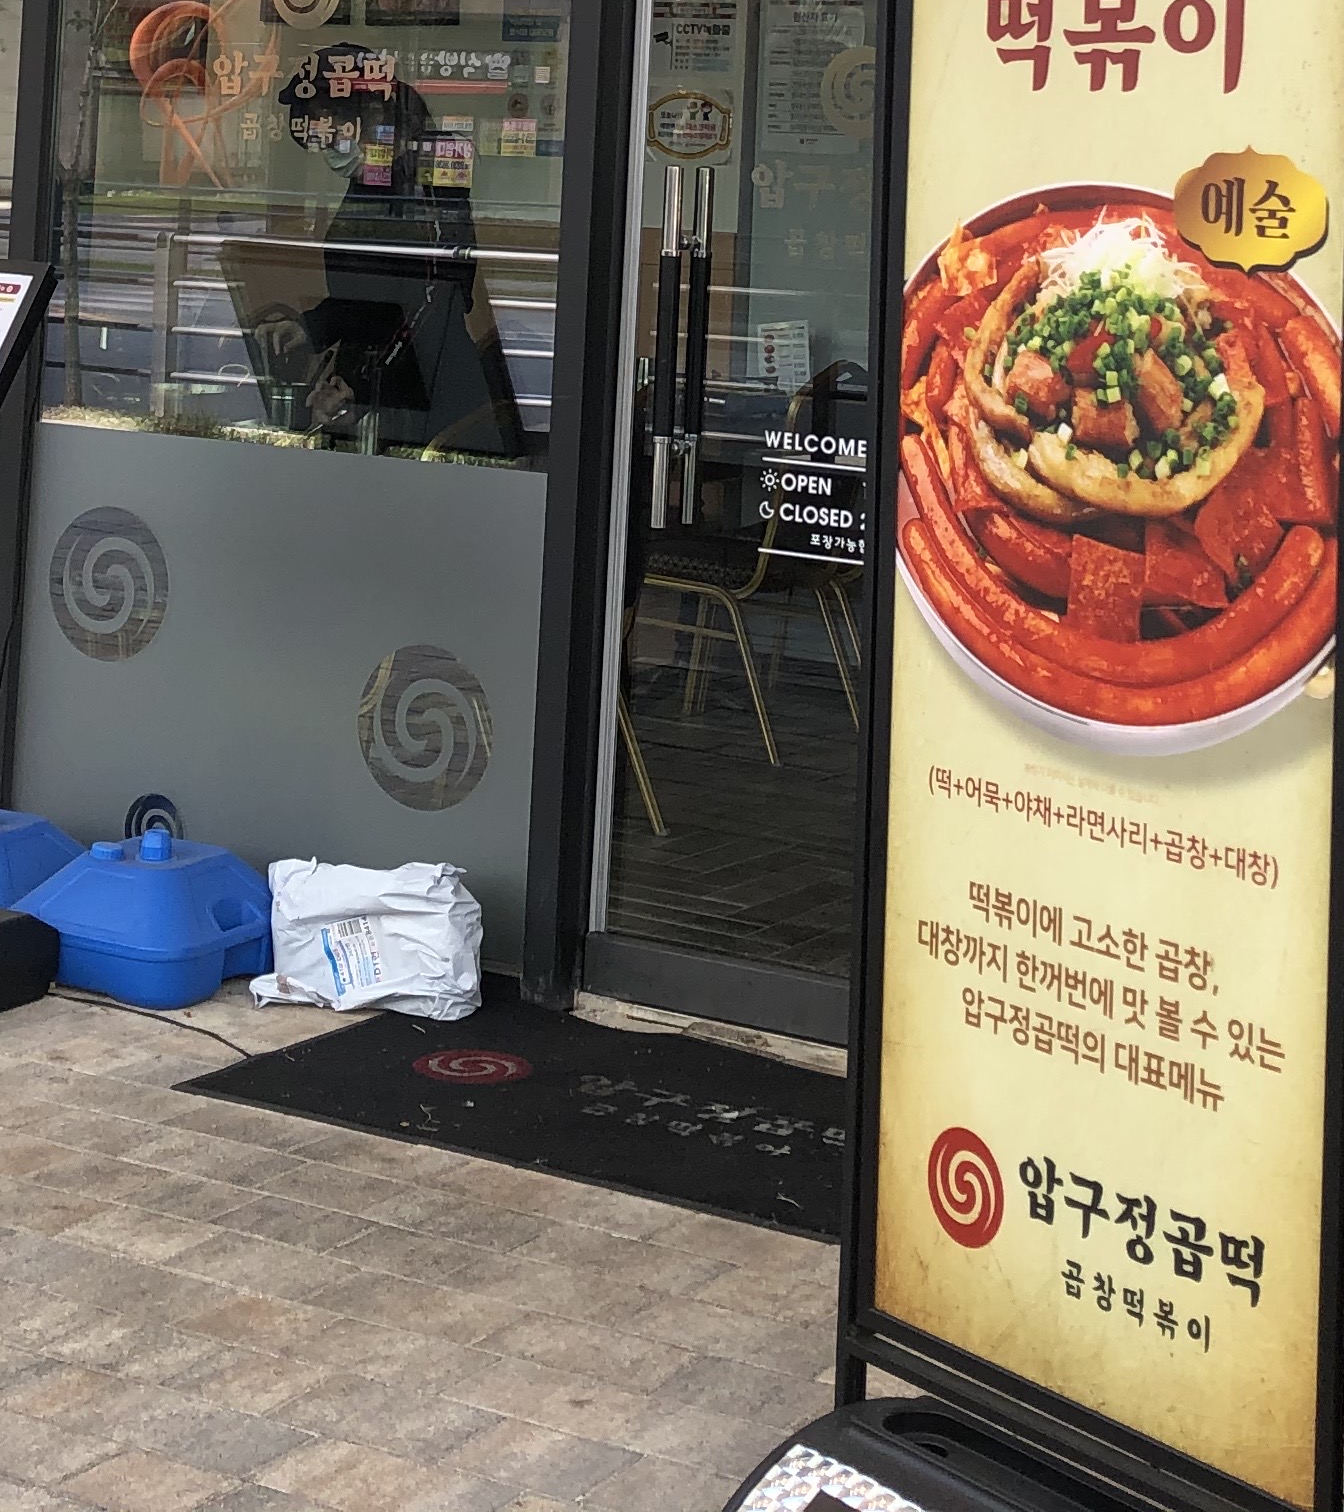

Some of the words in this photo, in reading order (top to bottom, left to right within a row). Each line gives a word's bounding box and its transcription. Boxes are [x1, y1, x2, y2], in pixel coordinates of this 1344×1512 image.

[213, 50, 397, 102] 압구정곱떡
[1200, 179, 1296, 242] 예술
[764, 429, 867, 458] WELCOME
[781, 473, 832, 496] OPEN
[779, 502, 853, 529] CLOSED
[927, 764, 1280, 889] (떡+어묵+야채+라면사리+곱창+대창)
[968, 880, 1063, 945] 떡볶이에
[1069, 913, 1149, 974] 고소한
[1154, 936, 1220, 998] 곱창,
[917, 919, 1009, 984] 대창까지
[1015, 947, 1115, 1021] 한꺼번에
[1121, 986, 1150, 1032] 맛
[1155, 996, 1183, 1041] 볼
[1190, 1008, 1219, 1049] 수
[1226, 1018, 1285, 1075] 있는
[961, 986, 1106, 1075] 압구정곱떡의
[1113, 1042, 1225, 1112] 대표메뉴
[1018, 1154, 1267, 1309] 압구정곱떡
[1060, 1258, 1211, 1354] 곱창떡볶이
